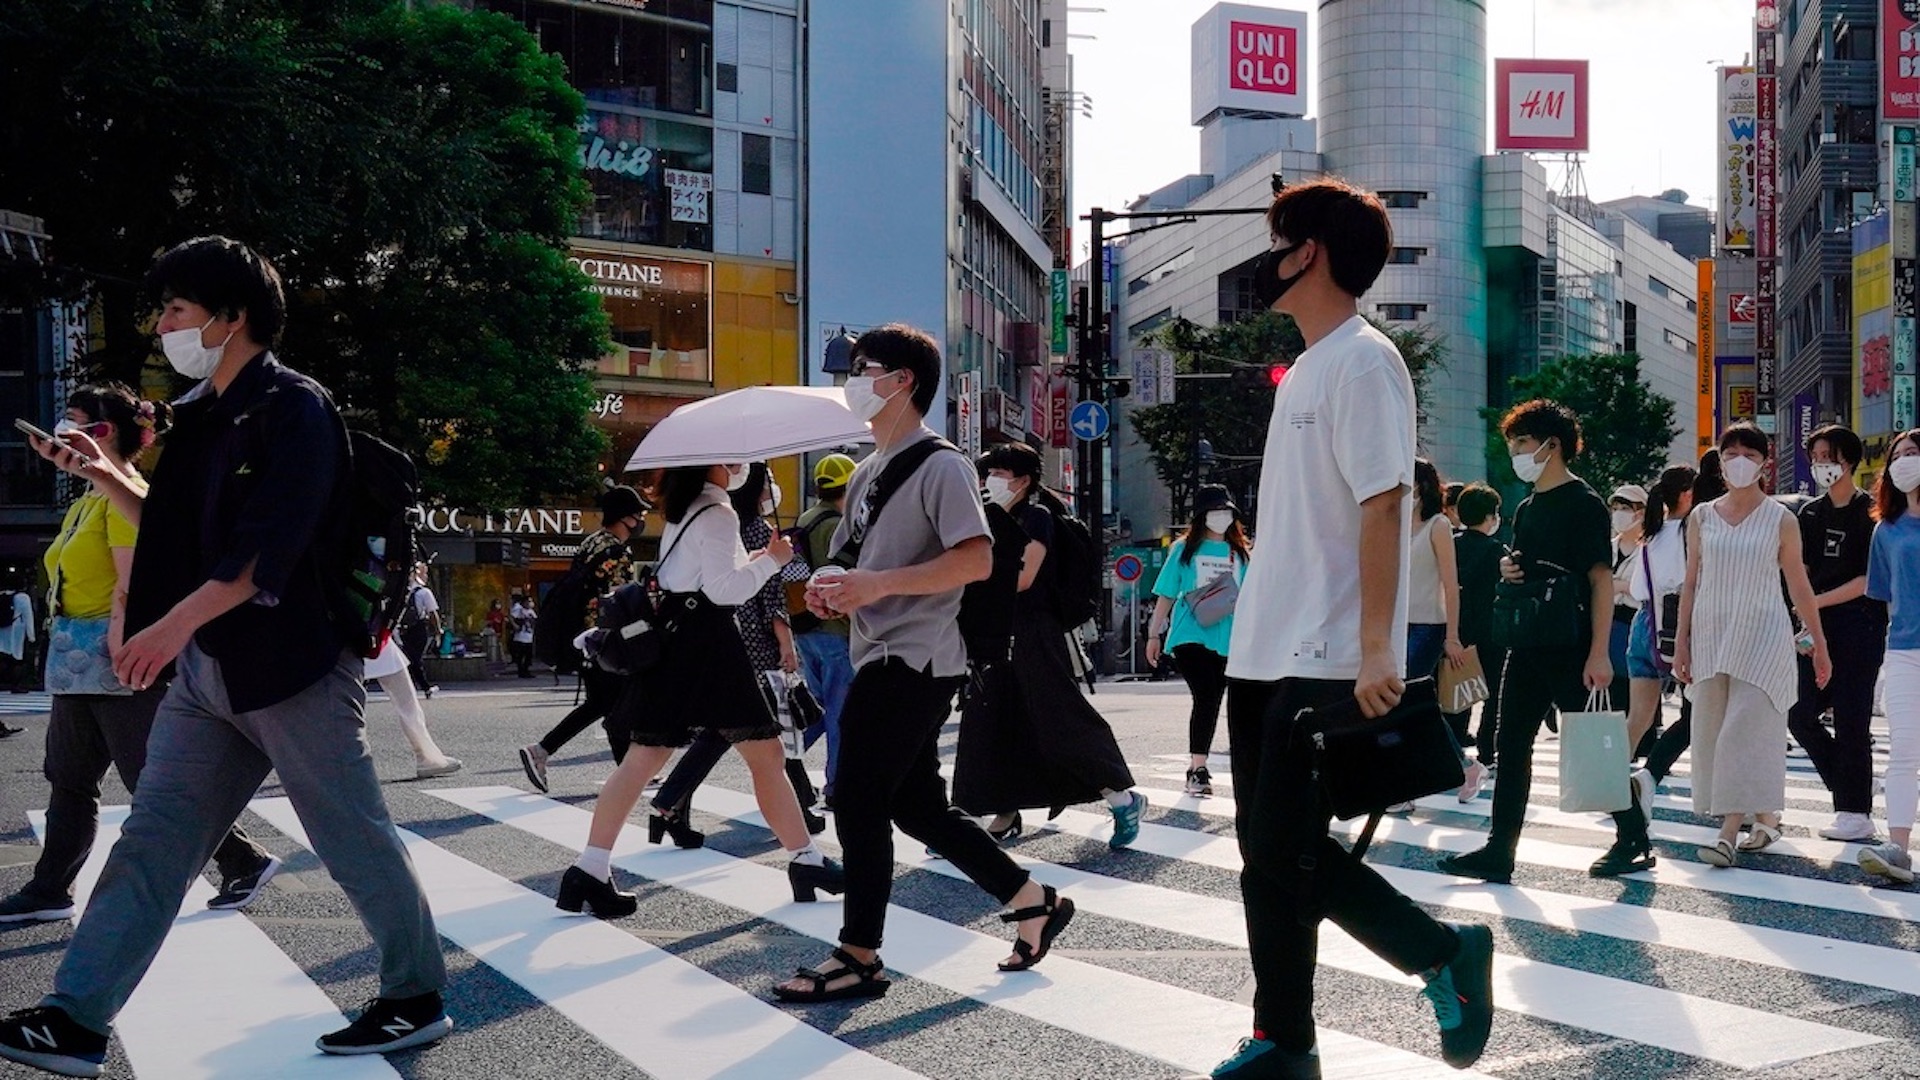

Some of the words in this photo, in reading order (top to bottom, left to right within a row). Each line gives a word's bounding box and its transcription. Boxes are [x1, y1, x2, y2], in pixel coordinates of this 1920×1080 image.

[1237, 29, 1285, 57] UNI
[1236, 59, 1290, 87] QLO
[1519, 90, 1566, 121] H&M
[666, 171, 711, 190] 焼肉弁当
[673, 190, 705, 203] テイク
[672, 205, 706, 219] アウト
[1701, 333, 1710, 395] Matsumoto
[1053, 398, 1065, 431] アコム
[1453, 675, 1490, 711] ZARA
[21, 1025, 58, 1049] N
[382, 1016, 415, 1037] N
